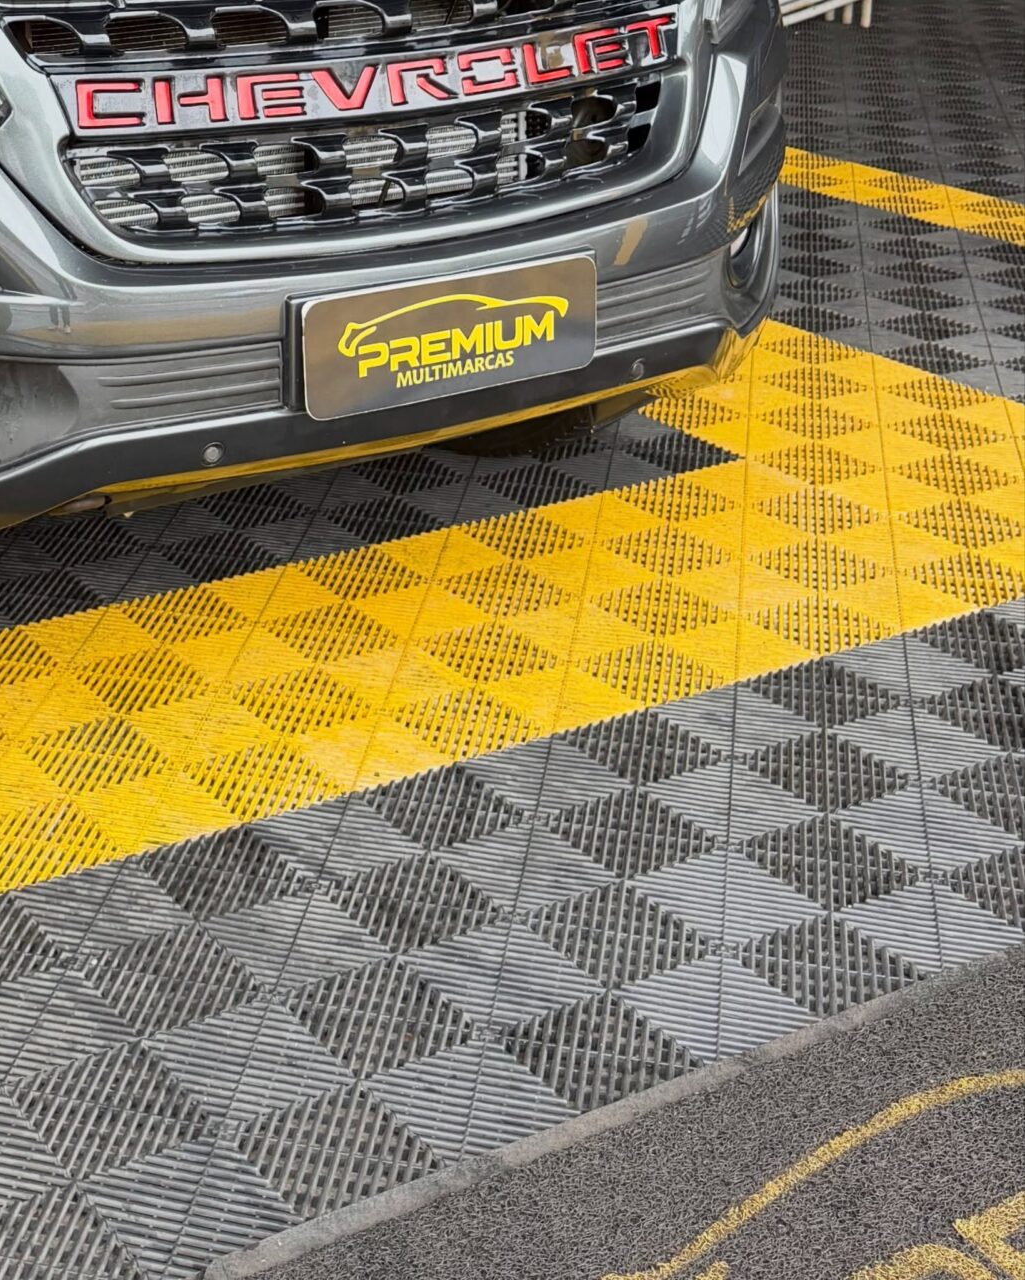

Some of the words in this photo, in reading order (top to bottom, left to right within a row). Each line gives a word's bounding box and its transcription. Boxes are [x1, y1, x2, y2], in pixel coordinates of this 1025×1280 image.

[75, 16, 672, 129] CHEVROLET
[358, 310, 555, 378] PREMIUM
[396, 350, 515, 389] MULTIMARCAS
